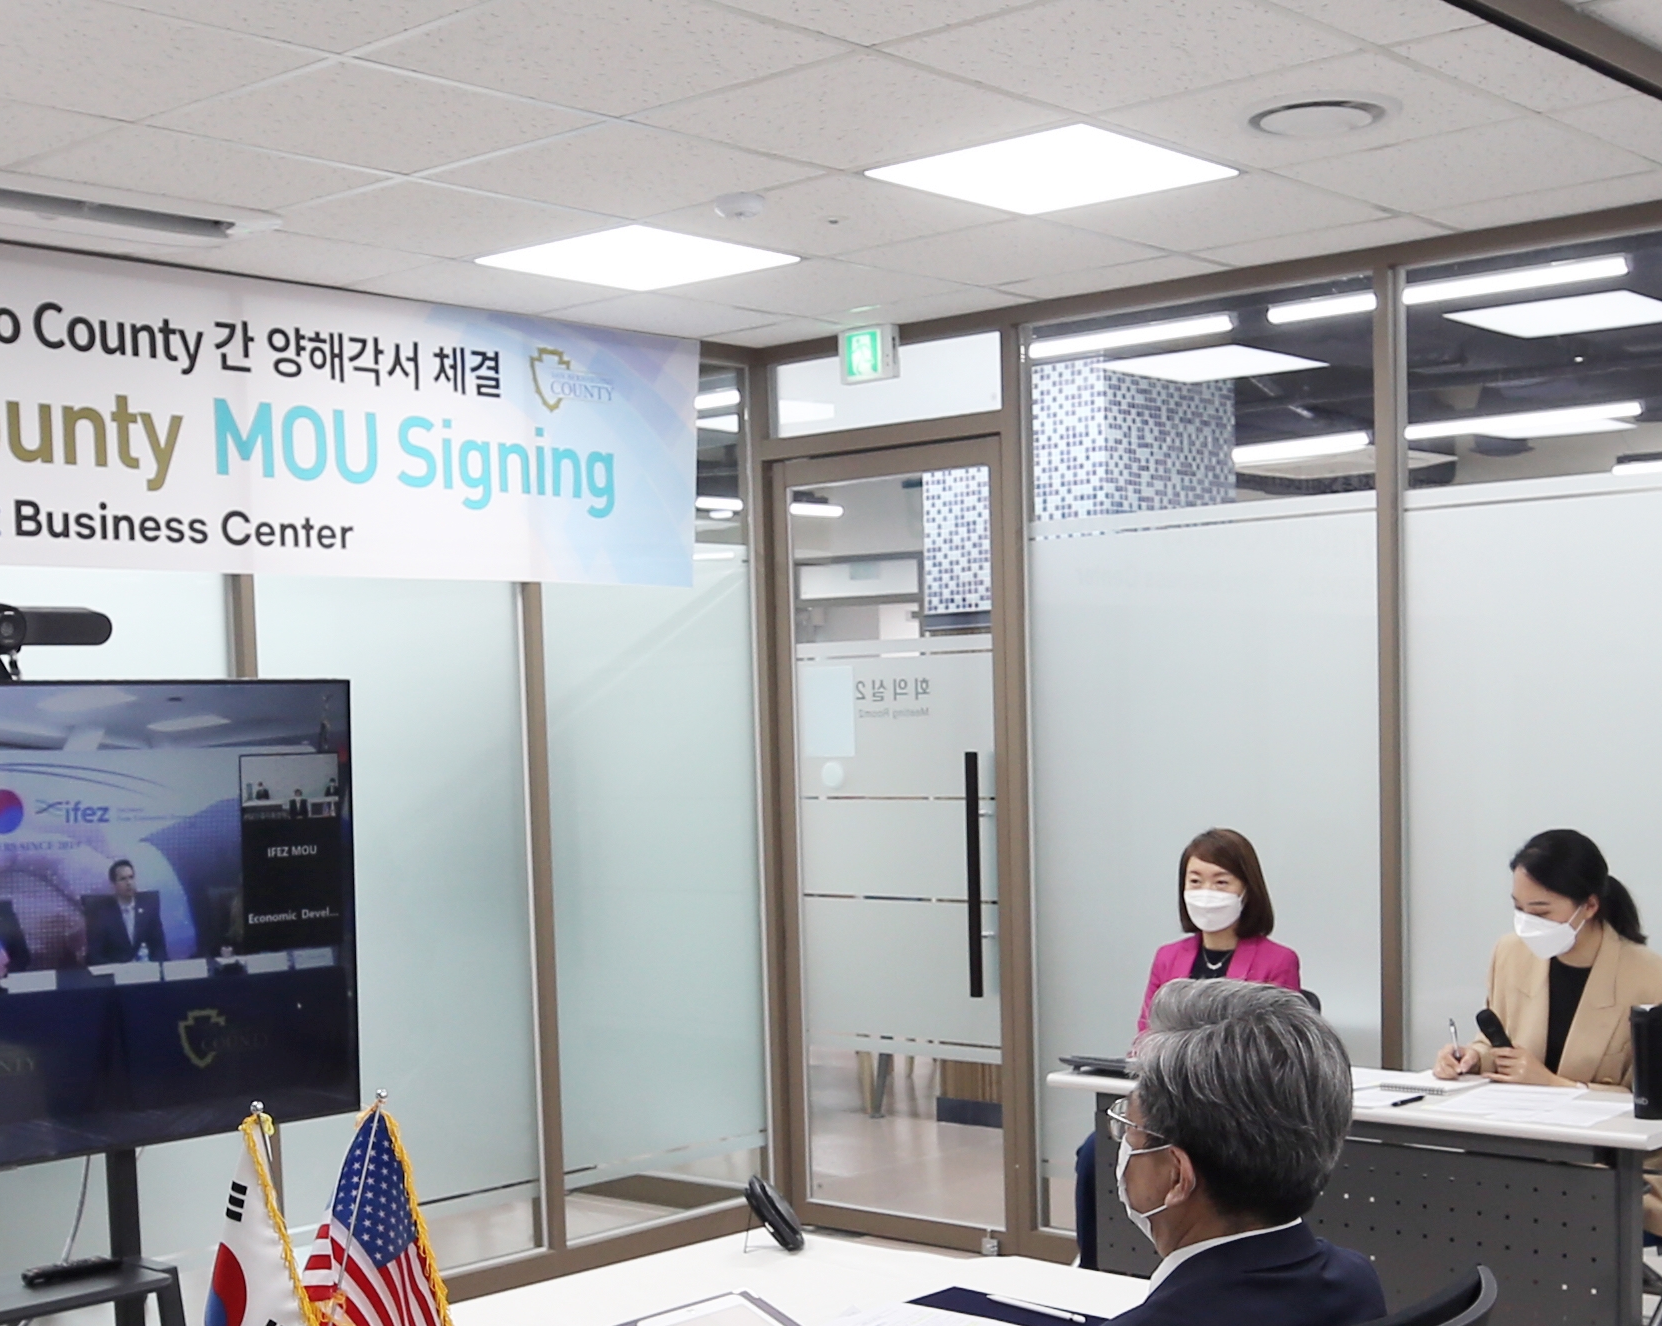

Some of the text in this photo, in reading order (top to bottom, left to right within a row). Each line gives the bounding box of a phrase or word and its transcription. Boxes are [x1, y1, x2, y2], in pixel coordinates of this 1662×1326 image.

[33, 302, 203, 375] County
[215, 321, 254, 372] 간
[267, 327, 419, 390] 양해각서
[433, 347, 500, 398] 체결
[550, 380, 614, 401] COUNTY
[214, 398, 377, 484] MOU
[398, 415, 615, 518] Signing
[15, 499, 208, 544] Business
[222, 511, 353, 549] Center
[63, 800, 111, 824] ifez
[267, 845, 317, 858] IFEZ MOU
[248, 911, 298, 924] Economic
